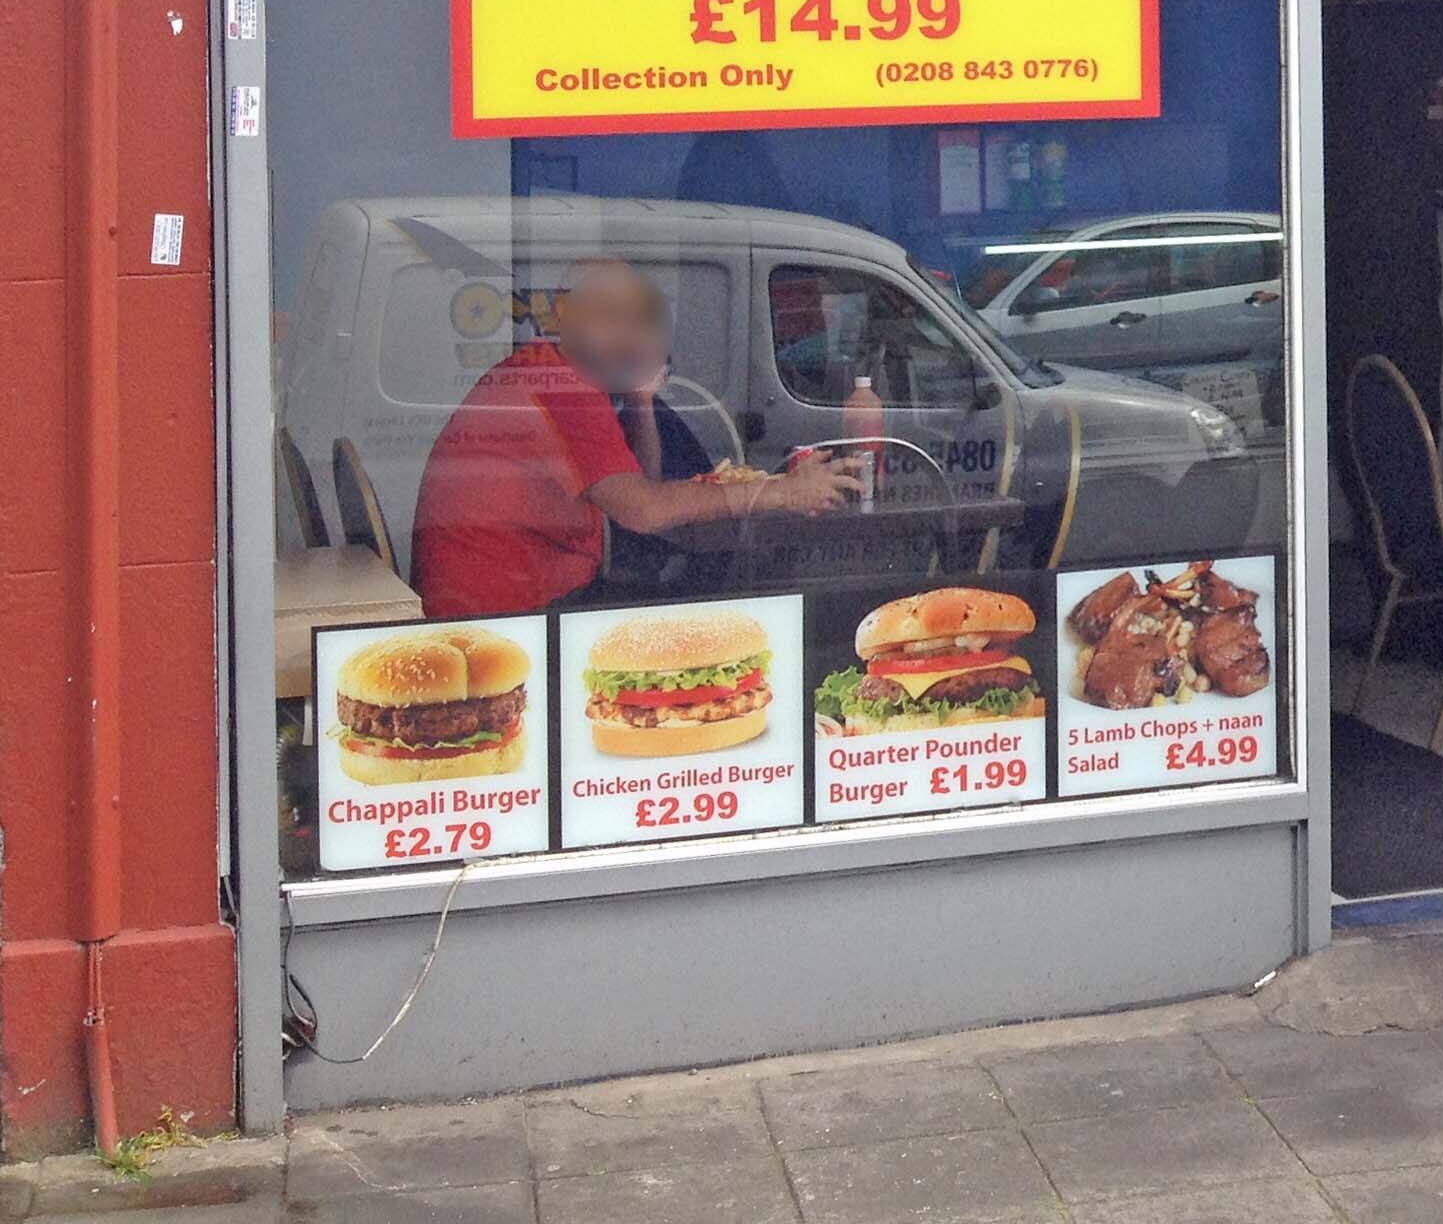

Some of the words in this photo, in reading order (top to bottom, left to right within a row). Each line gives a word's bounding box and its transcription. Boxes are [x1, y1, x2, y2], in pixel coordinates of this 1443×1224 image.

[535, 66, 708, 92] Collection
[720, 64, 794, 91] Only
[876, 61, 954, 88] (0208
[964, 60, 1014, 80] 843
[1024, 58, 1099, 82] 0776)
[1068, 728, 1079, 745] 5
[1084, 722, 1136, 744] Lamb
[1140, 717, 1198, 743] Chops
[1217, 712, 1264, 730] naan
[828, 746, 919, 771] Quarter
[925, 733, 1022, 761] Pounder
[1067, 753, 1120, 775] Salad
[1166, 735, 1258, 770] £4.99
[572, 775, 652, 799] Chicken
[657, 766, 723, 791] Grilled
[728, 761, 795, 786] Burger
[828, 779, 908, 806] Burger
[930, 758, 1027, 795] £1.99
[328, 791, 446, 825] Chappali
[453, 785, 542, 816] Burger
[636, 791, 739, 828] £2.99
[384, 821, 492, 860] £2.79
